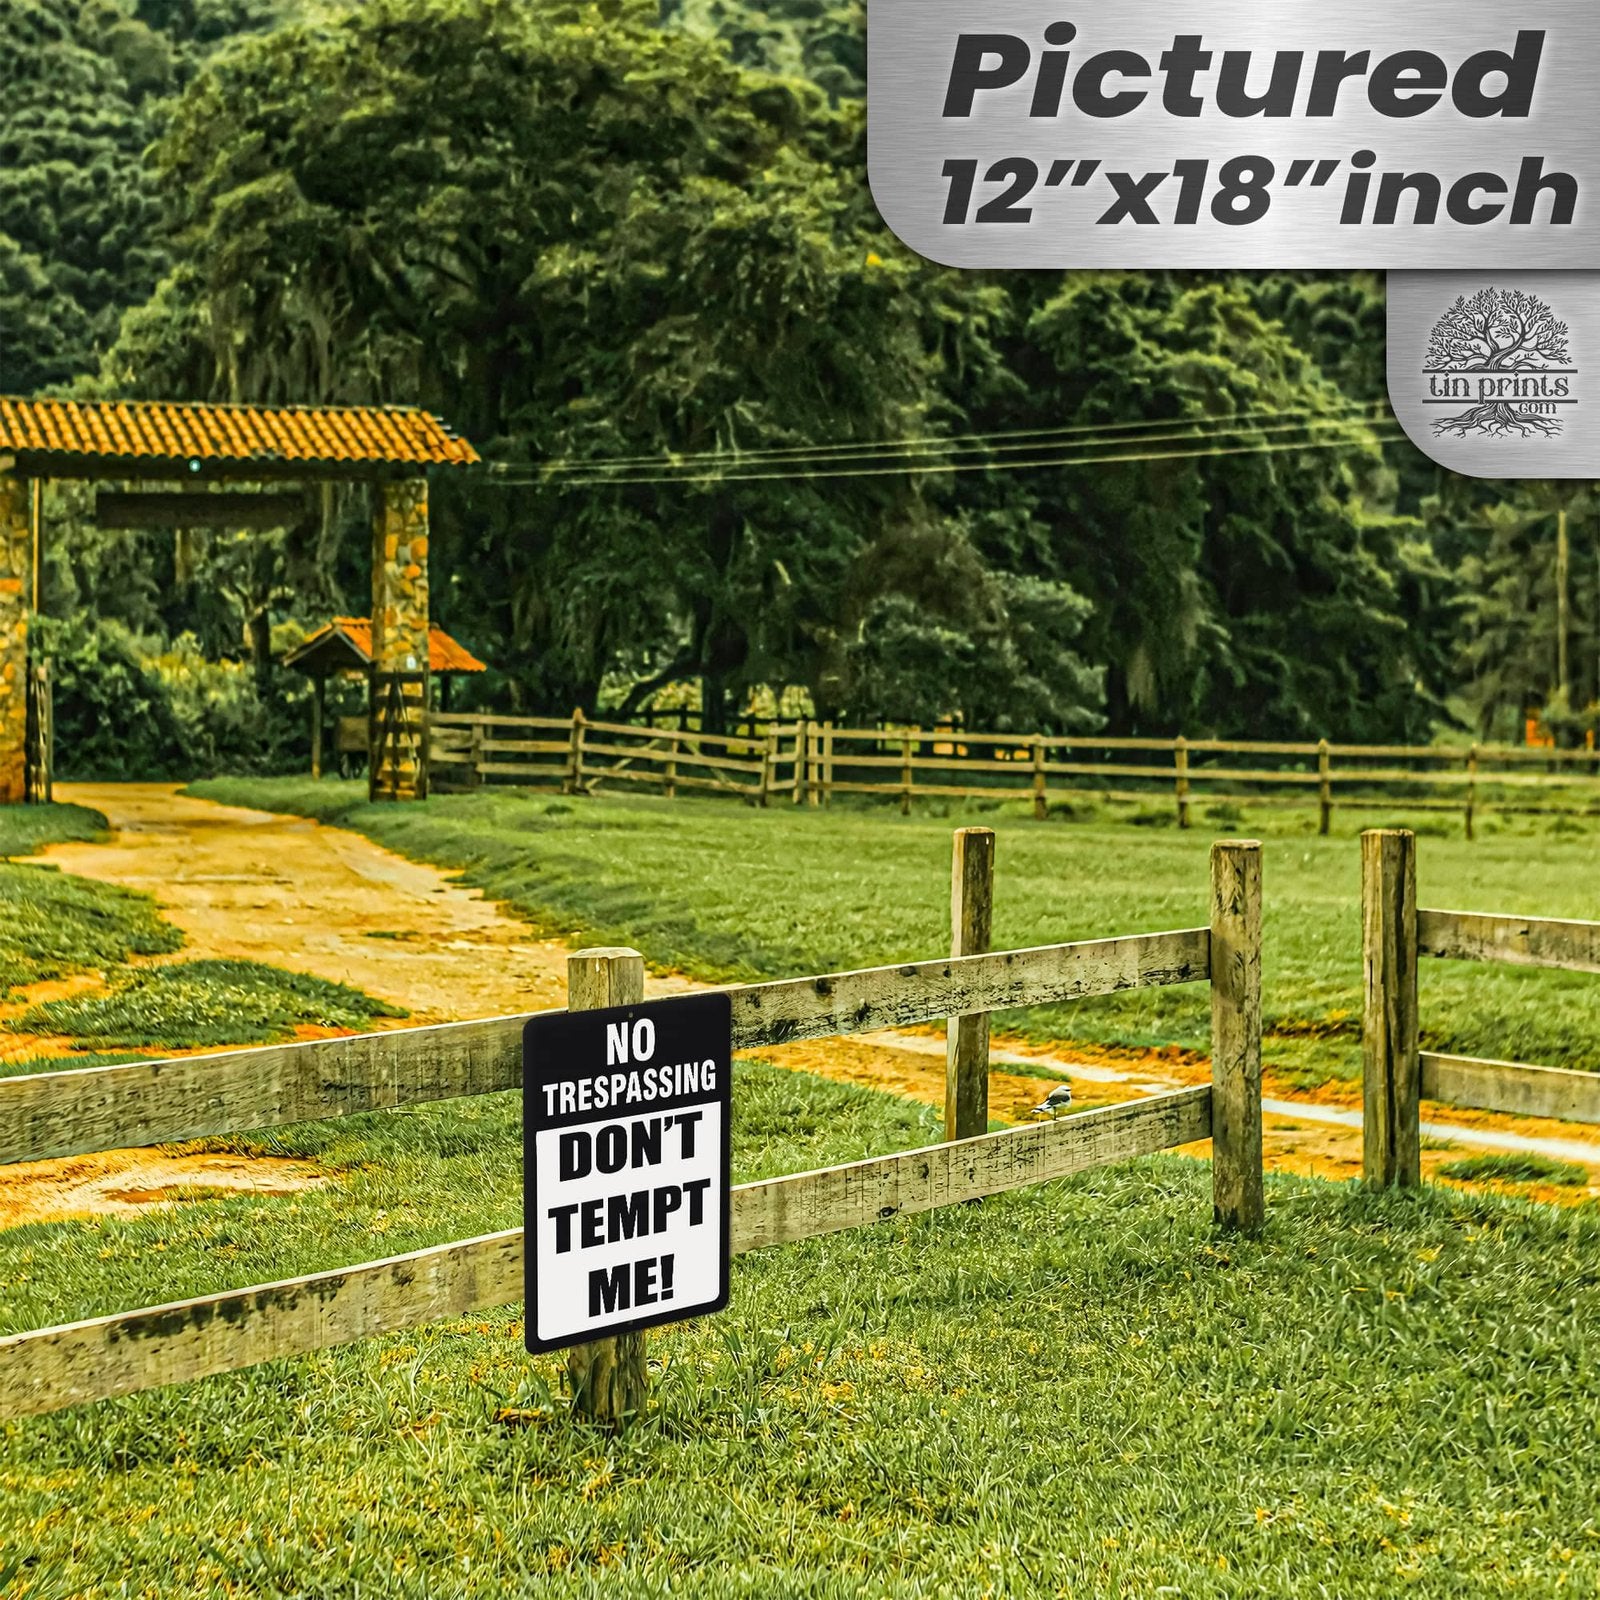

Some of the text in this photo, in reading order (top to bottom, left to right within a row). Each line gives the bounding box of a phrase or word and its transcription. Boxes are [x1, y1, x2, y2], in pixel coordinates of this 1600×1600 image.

[606, 1018, 656, 1065] NO
[542, 1059, 717, 1116] TRESPASSING
[559, 1110, 703, 1182] DON'T
[547, 1178, 711, 1254] TEMPT
[588, 1253, 675, 1318] ME!
